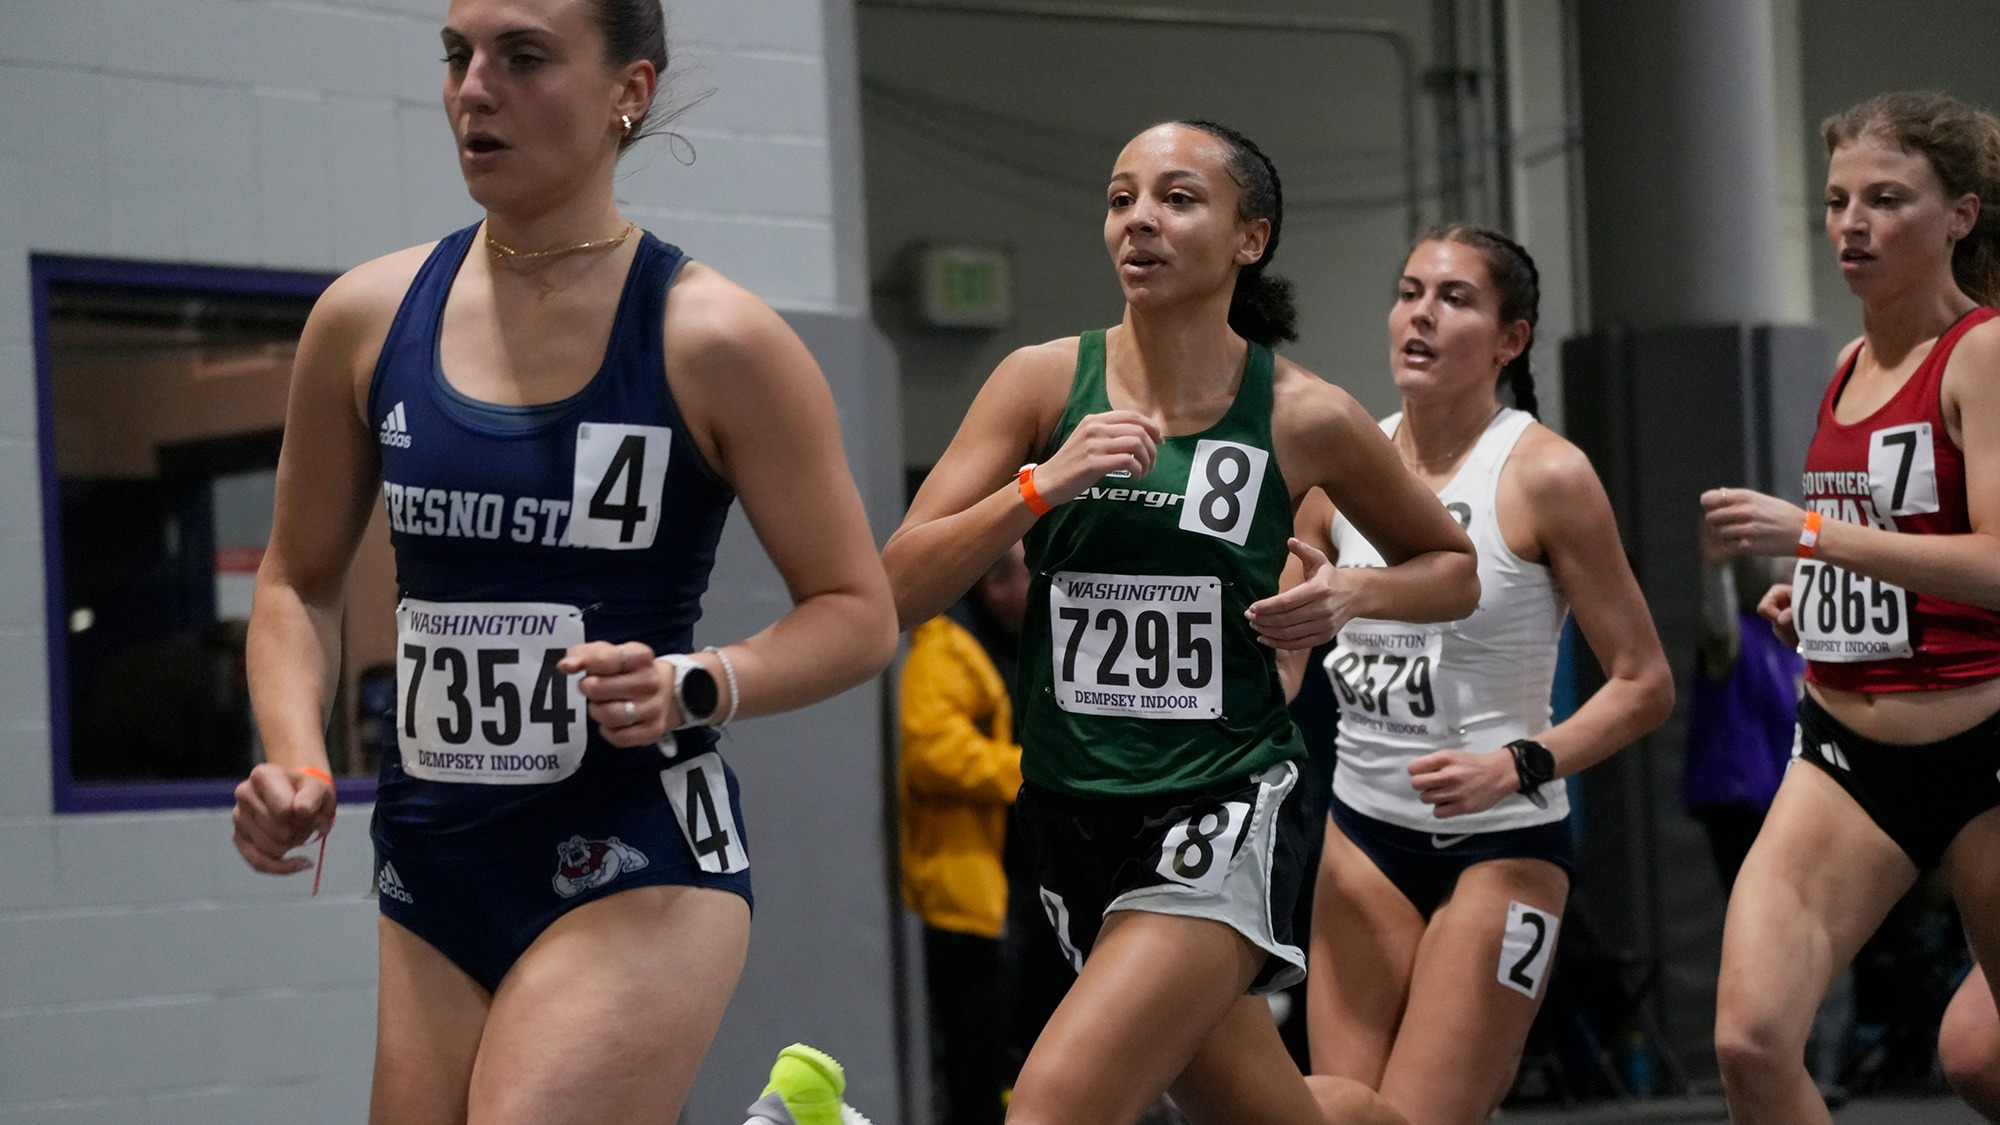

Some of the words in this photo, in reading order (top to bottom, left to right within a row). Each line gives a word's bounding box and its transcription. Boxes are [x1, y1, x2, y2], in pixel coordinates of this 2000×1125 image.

[379, 430, 411, 449] adidas
[1882, 431, 1916, 510] 7
[588, 434, 647, 543] 4
[1199, 446, 1251, 532] 8
[410, 611, 558, 635] WASHINGTON
[1067, 581, 1201, 601] WASHINGTON
[1798, 565, 1898, 635] 7865
[1059, 607, 1212, 689] 7295
[1845, 641, 1890, 653] INDOOR
[404, 643, 576, 746] 7354
[1075, 690, 1136, 708] DEMPSEY
[1140, 695, 1198, 709] INDOOR
[418, 749, 485, 770] DEMPSEY
[490, 754, 560, 771] INDOOR
[686, 766, 730, 872] 4
[1172, 803, 1230, 880] 8
[1509, 912, 1545, 990] 2
